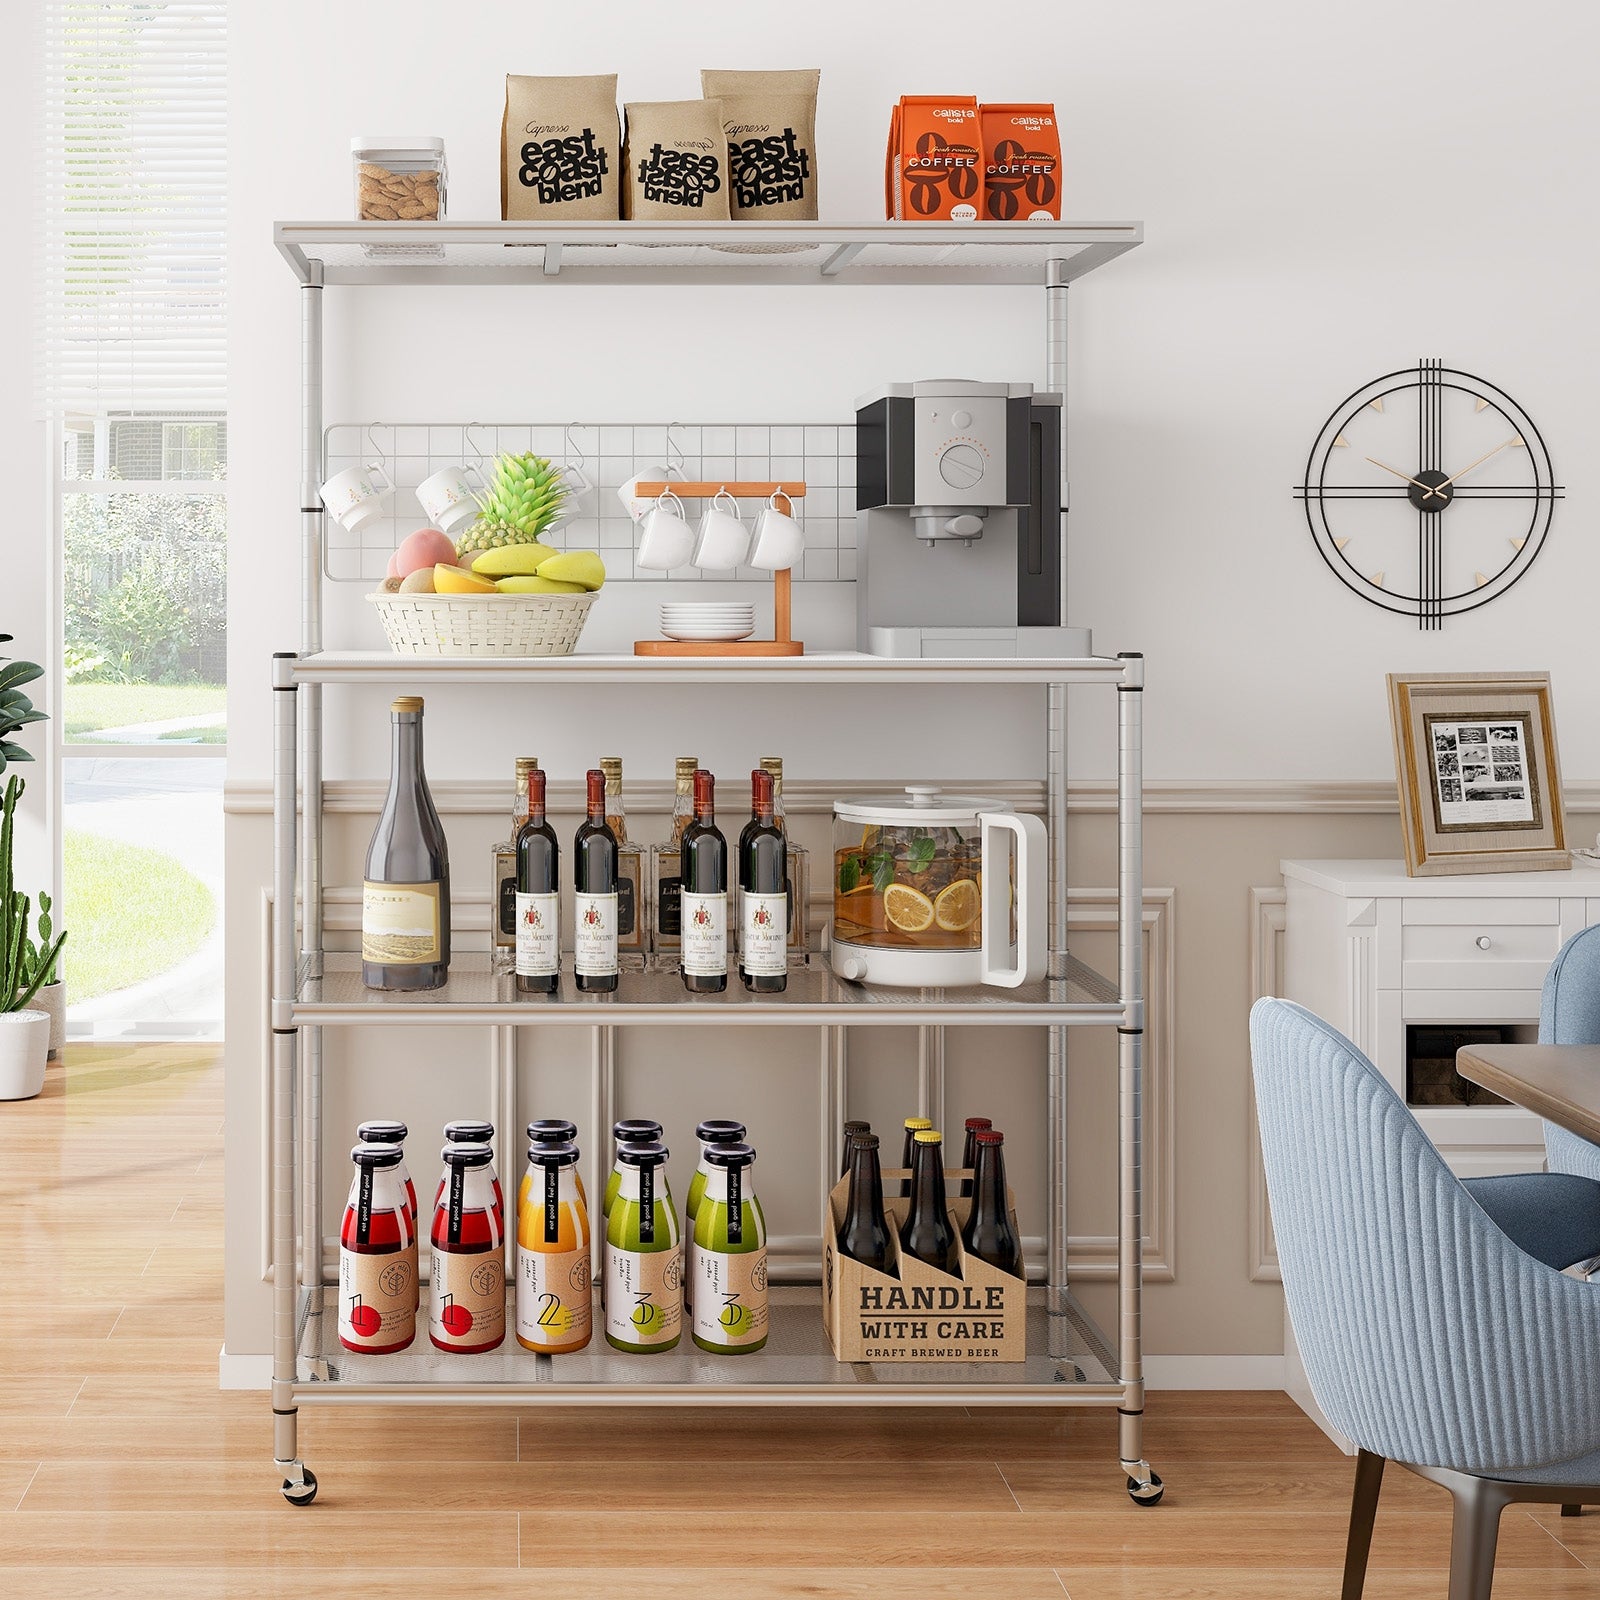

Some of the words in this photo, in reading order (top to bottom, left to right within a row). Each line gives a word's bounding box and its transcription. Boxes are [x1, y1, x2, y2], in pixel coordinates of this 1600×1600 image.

[523, 121, 569, 137] Capresso
[724, 120, 770, 138] Capresso
[521, 128, 596, 165] east
[519, 147, 608, 187] coast
[908, 158, 974, 166] COFFEE
[987, 164, 1052, 174] COFFEE
[538, 173, 602, 204] blend
[737, 177, 804, 208] blend
[382, 1266, 396, 1279] RAW
[474, 1266, 487, 1279] RAW
[629, 1292, 654, 1324] 3
[717, 1292, 742, 1325] 3
[860, 1287, 1004, 1310] HANDLE
[537, 1293, 562, 1326] 2
[860, 1322, 928, 1338] WITH
[937, 1322, 1004, 1339] CARE
[866, 1348, 906, 1357] CRAFT
[911, 1348, 962, 1357] BREWED
[968, 1348, 999, 1357] BEER
